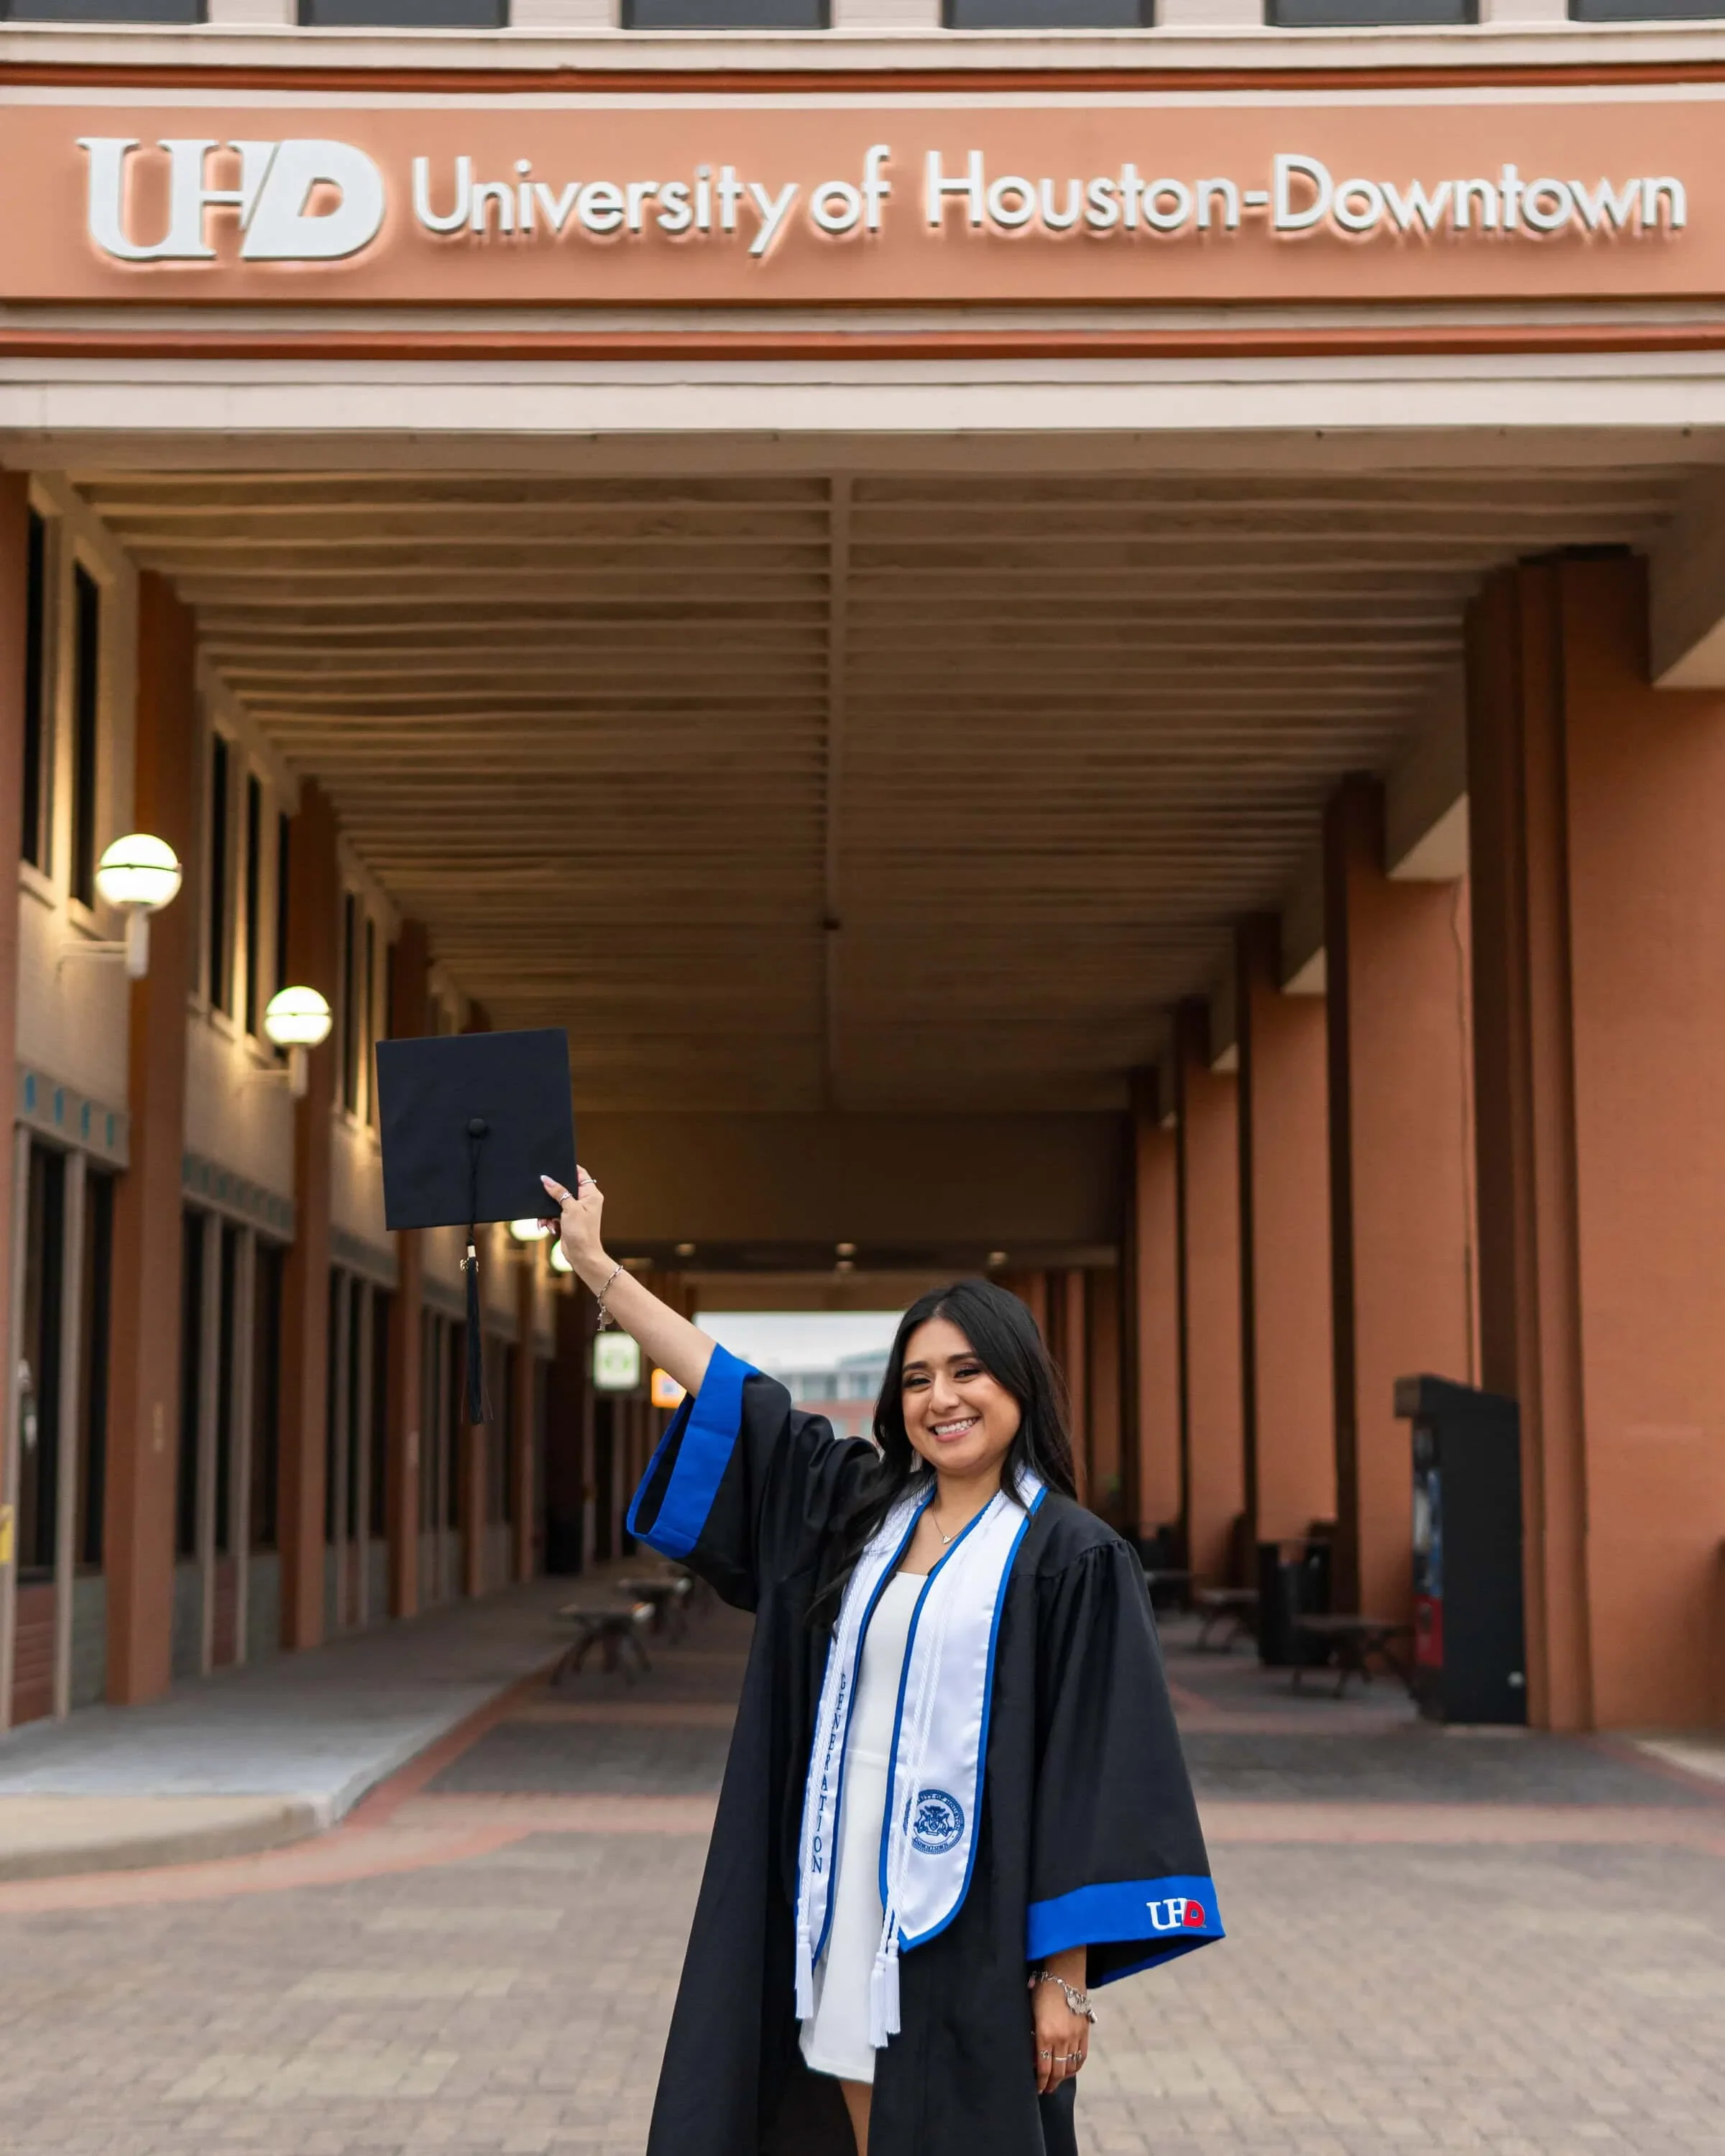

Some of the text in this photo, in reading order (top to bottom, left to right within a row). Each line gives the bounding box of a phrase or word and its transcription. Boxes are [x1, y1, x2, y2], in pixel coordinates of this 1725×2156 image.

[75, 137, 385, 260] UHD
[413, 144, 1687, 257] University of Houston-Downtown
[811, 1672, 846, 1873] GENERATION
[1146, 1897, 1205, 1930] UHD
